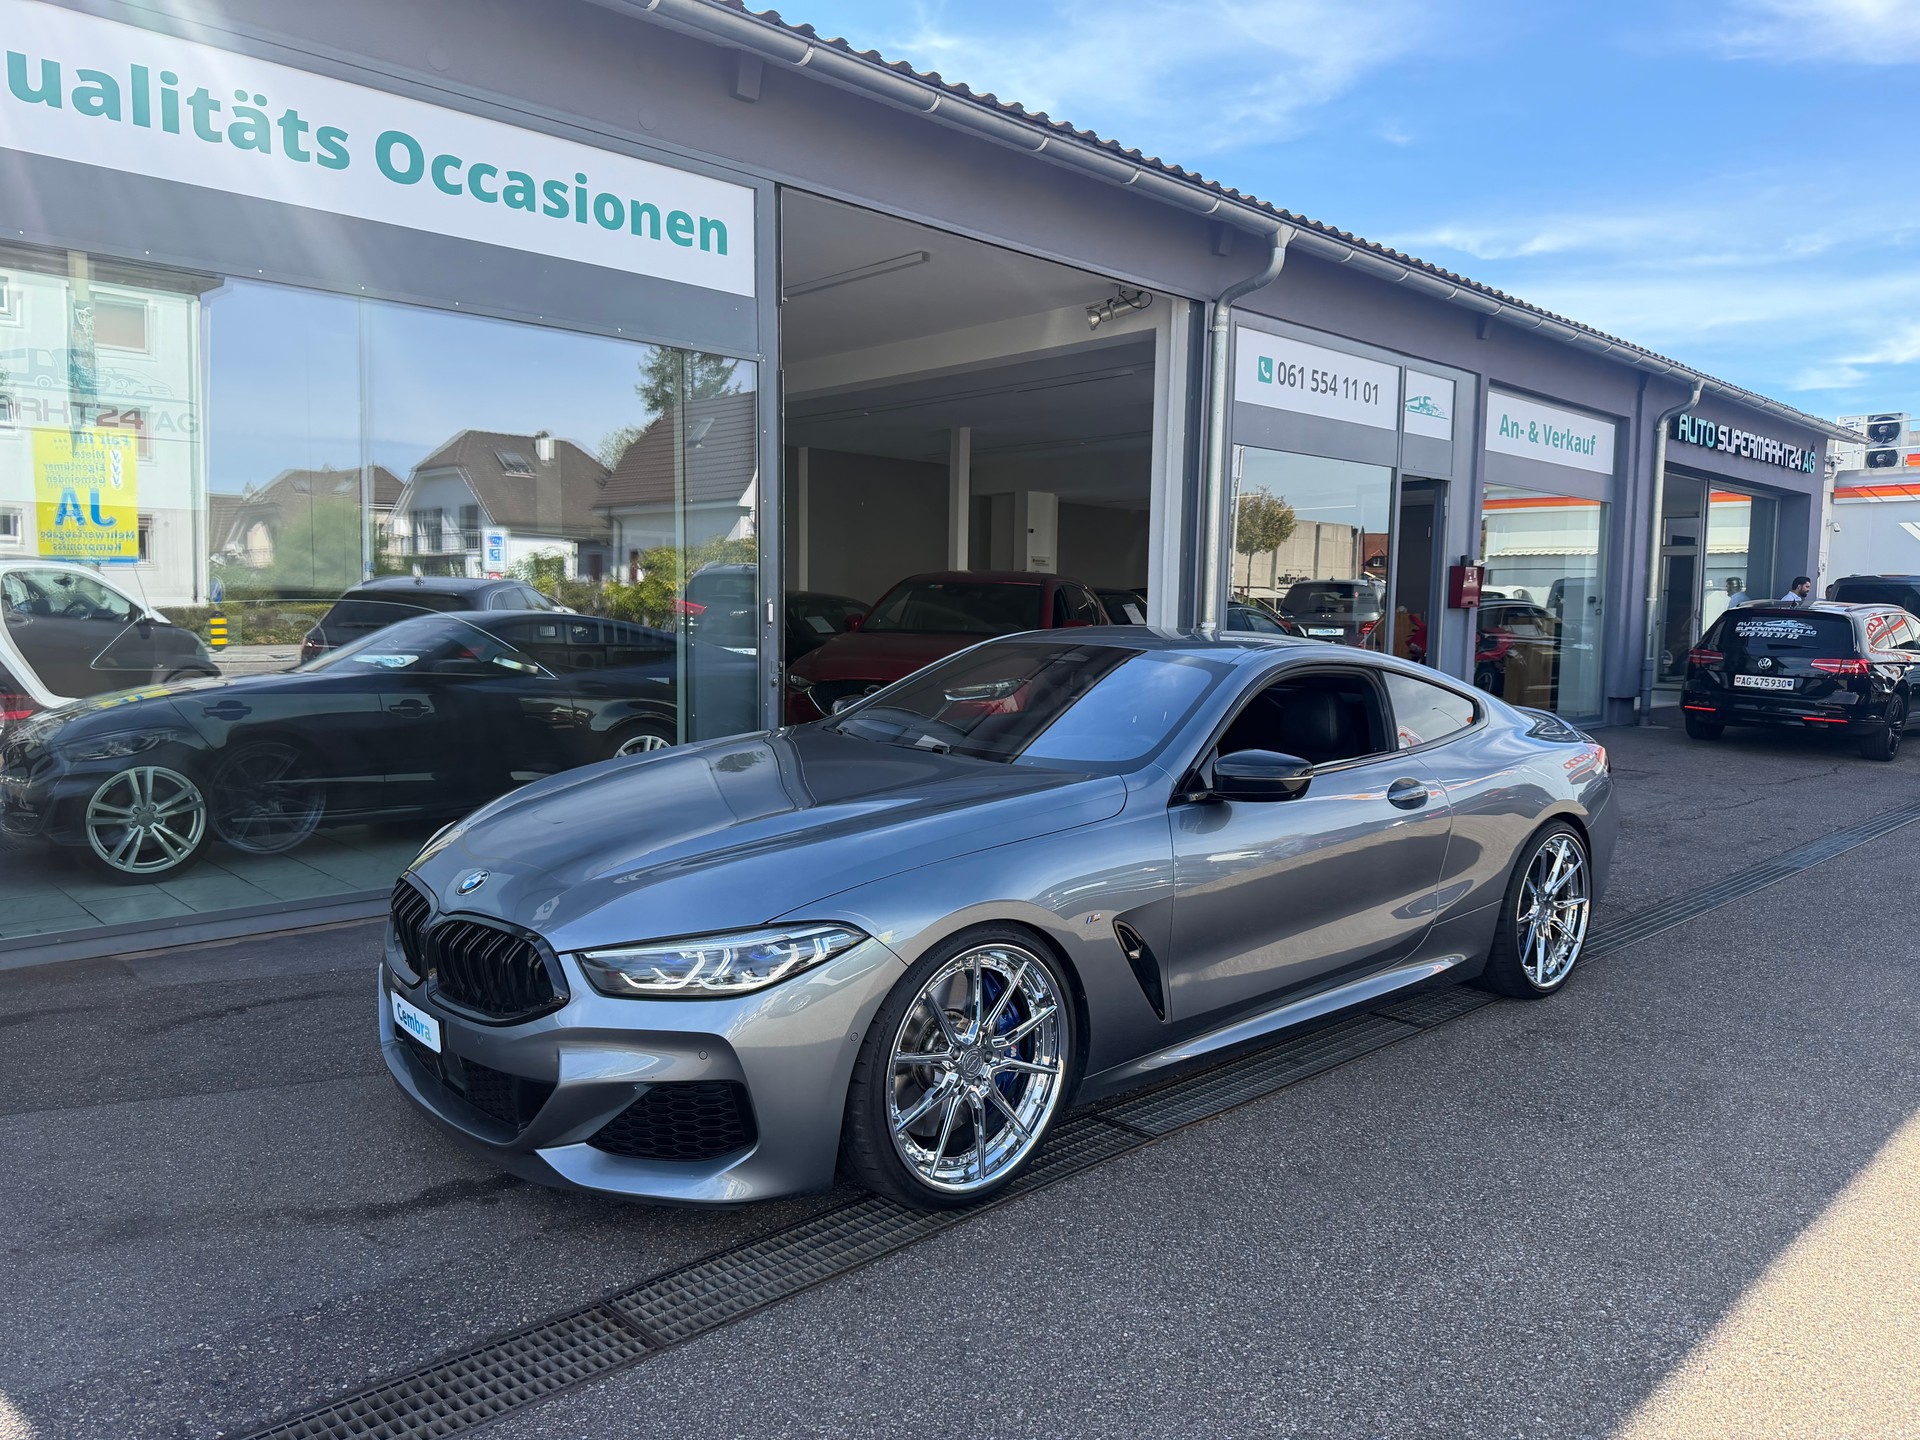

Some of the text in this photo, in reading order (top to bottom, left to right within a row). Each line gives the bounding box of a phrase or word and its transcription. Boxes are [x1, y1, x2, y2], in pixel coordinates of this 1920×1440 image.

[6, 50, 729, 256] ualitäts Occasionen
[1277, 361, 1379, 406] 061 554 11 01
[1499, 414, 1596, 457] An- & Verkauf
[1678, 414, 1716, 448] AUTO
[1802, 450, 1816, 474] AG
